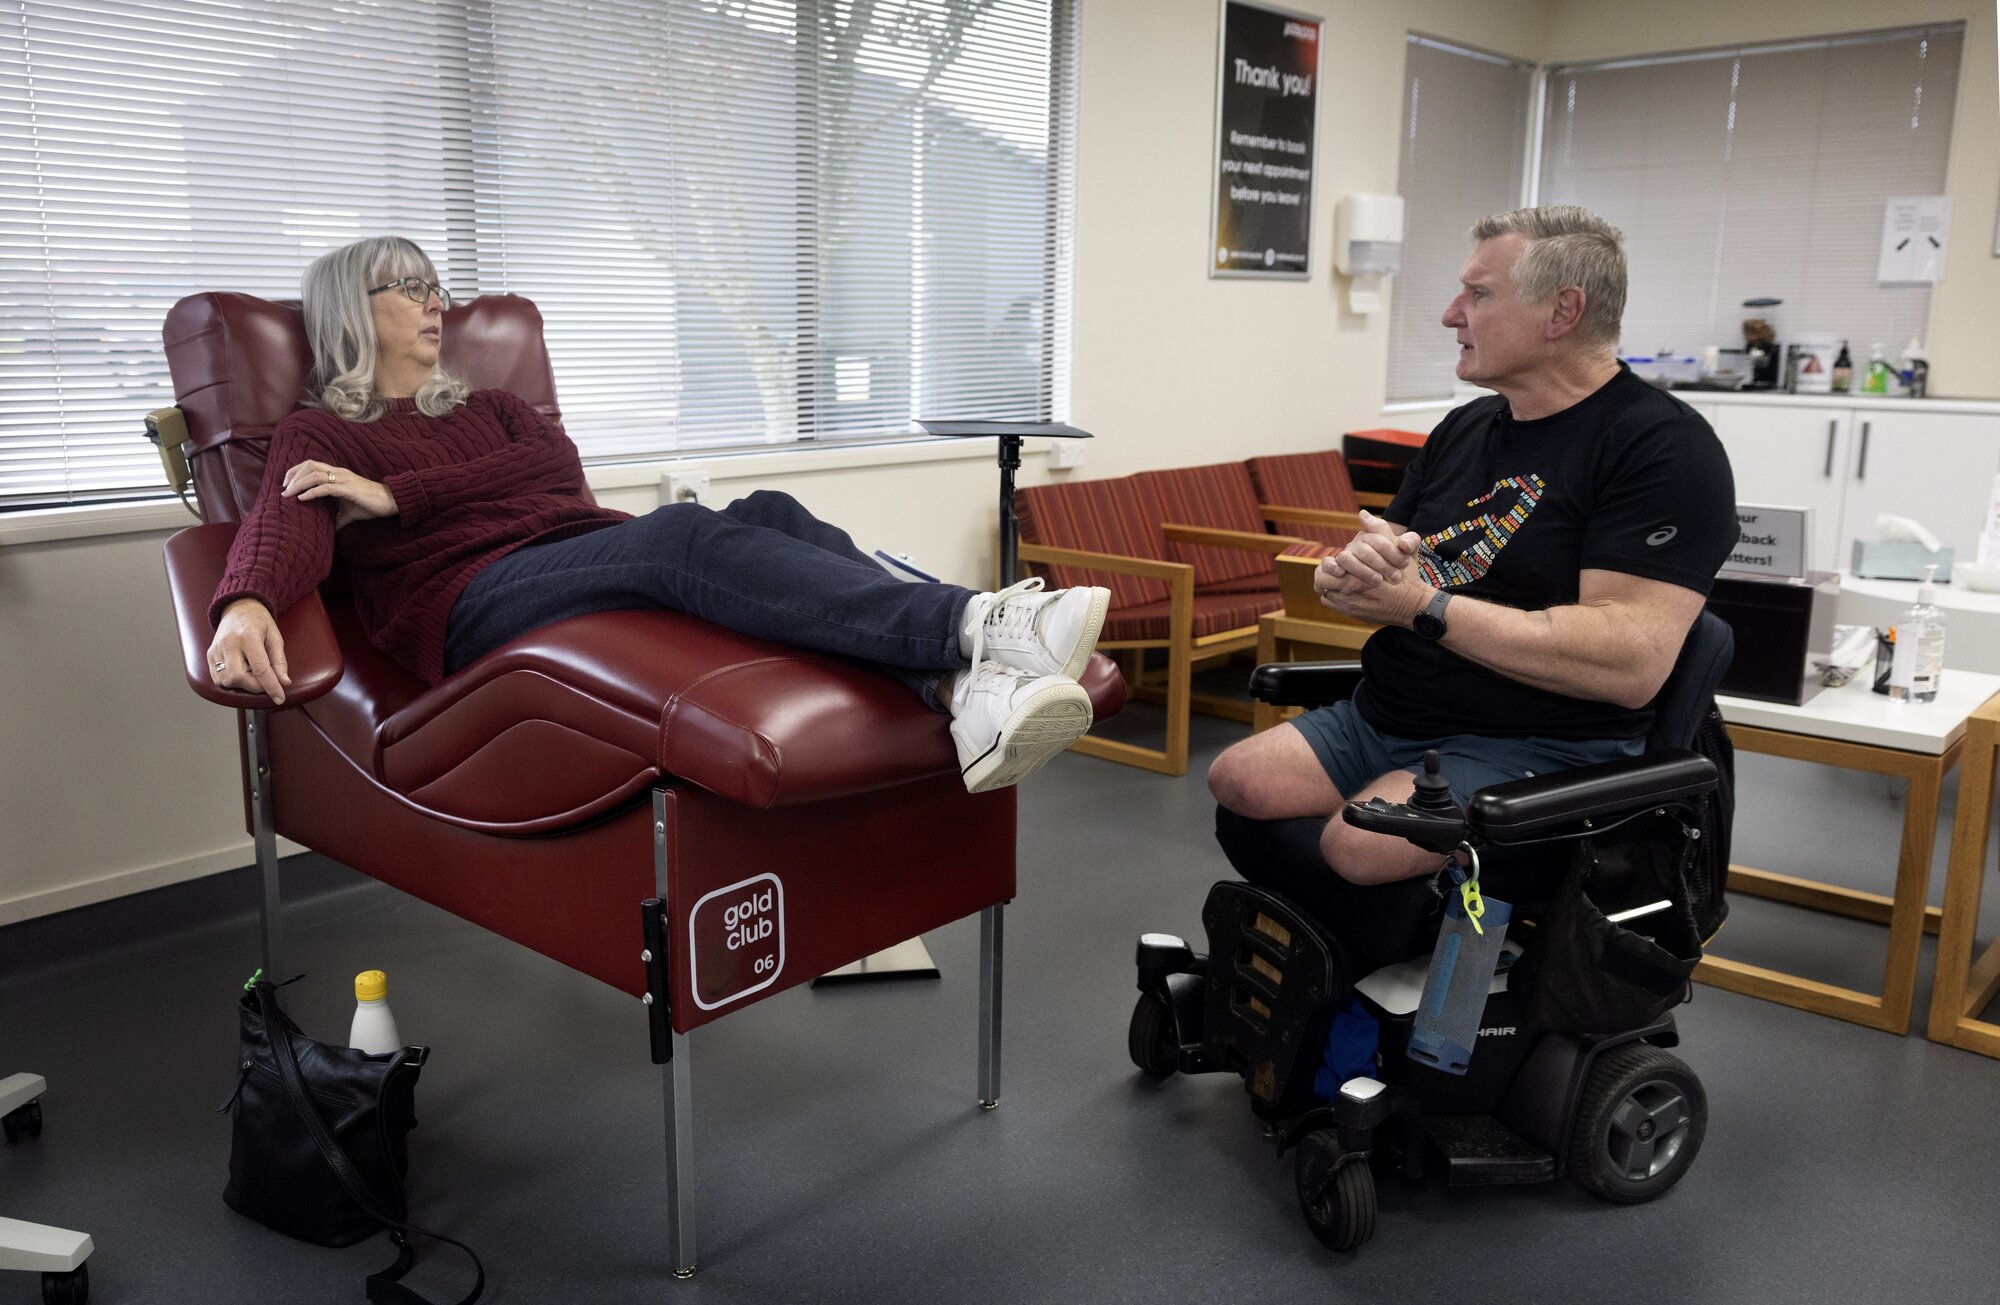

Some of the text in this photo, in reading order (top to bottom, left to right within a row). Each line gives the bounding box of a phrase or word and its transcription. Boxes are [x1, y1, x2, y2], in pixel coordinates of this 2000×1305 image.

[1234, 57, 1312, 97] Thank you!
[1230, 129, 1277, 150] Remember
[1278, 137, 1286, 152] to
[1221, 159, 1310, 181] your next appointment
[1230, 184, 1260, 202] before
[1261, 190, 1277, 205] you
[724, 887, 772, 931] gold
[726, 917, 773, 951] club
[754, 954, 775, 974] 06
[1477, 1026, 1517, 1037] HAIR
